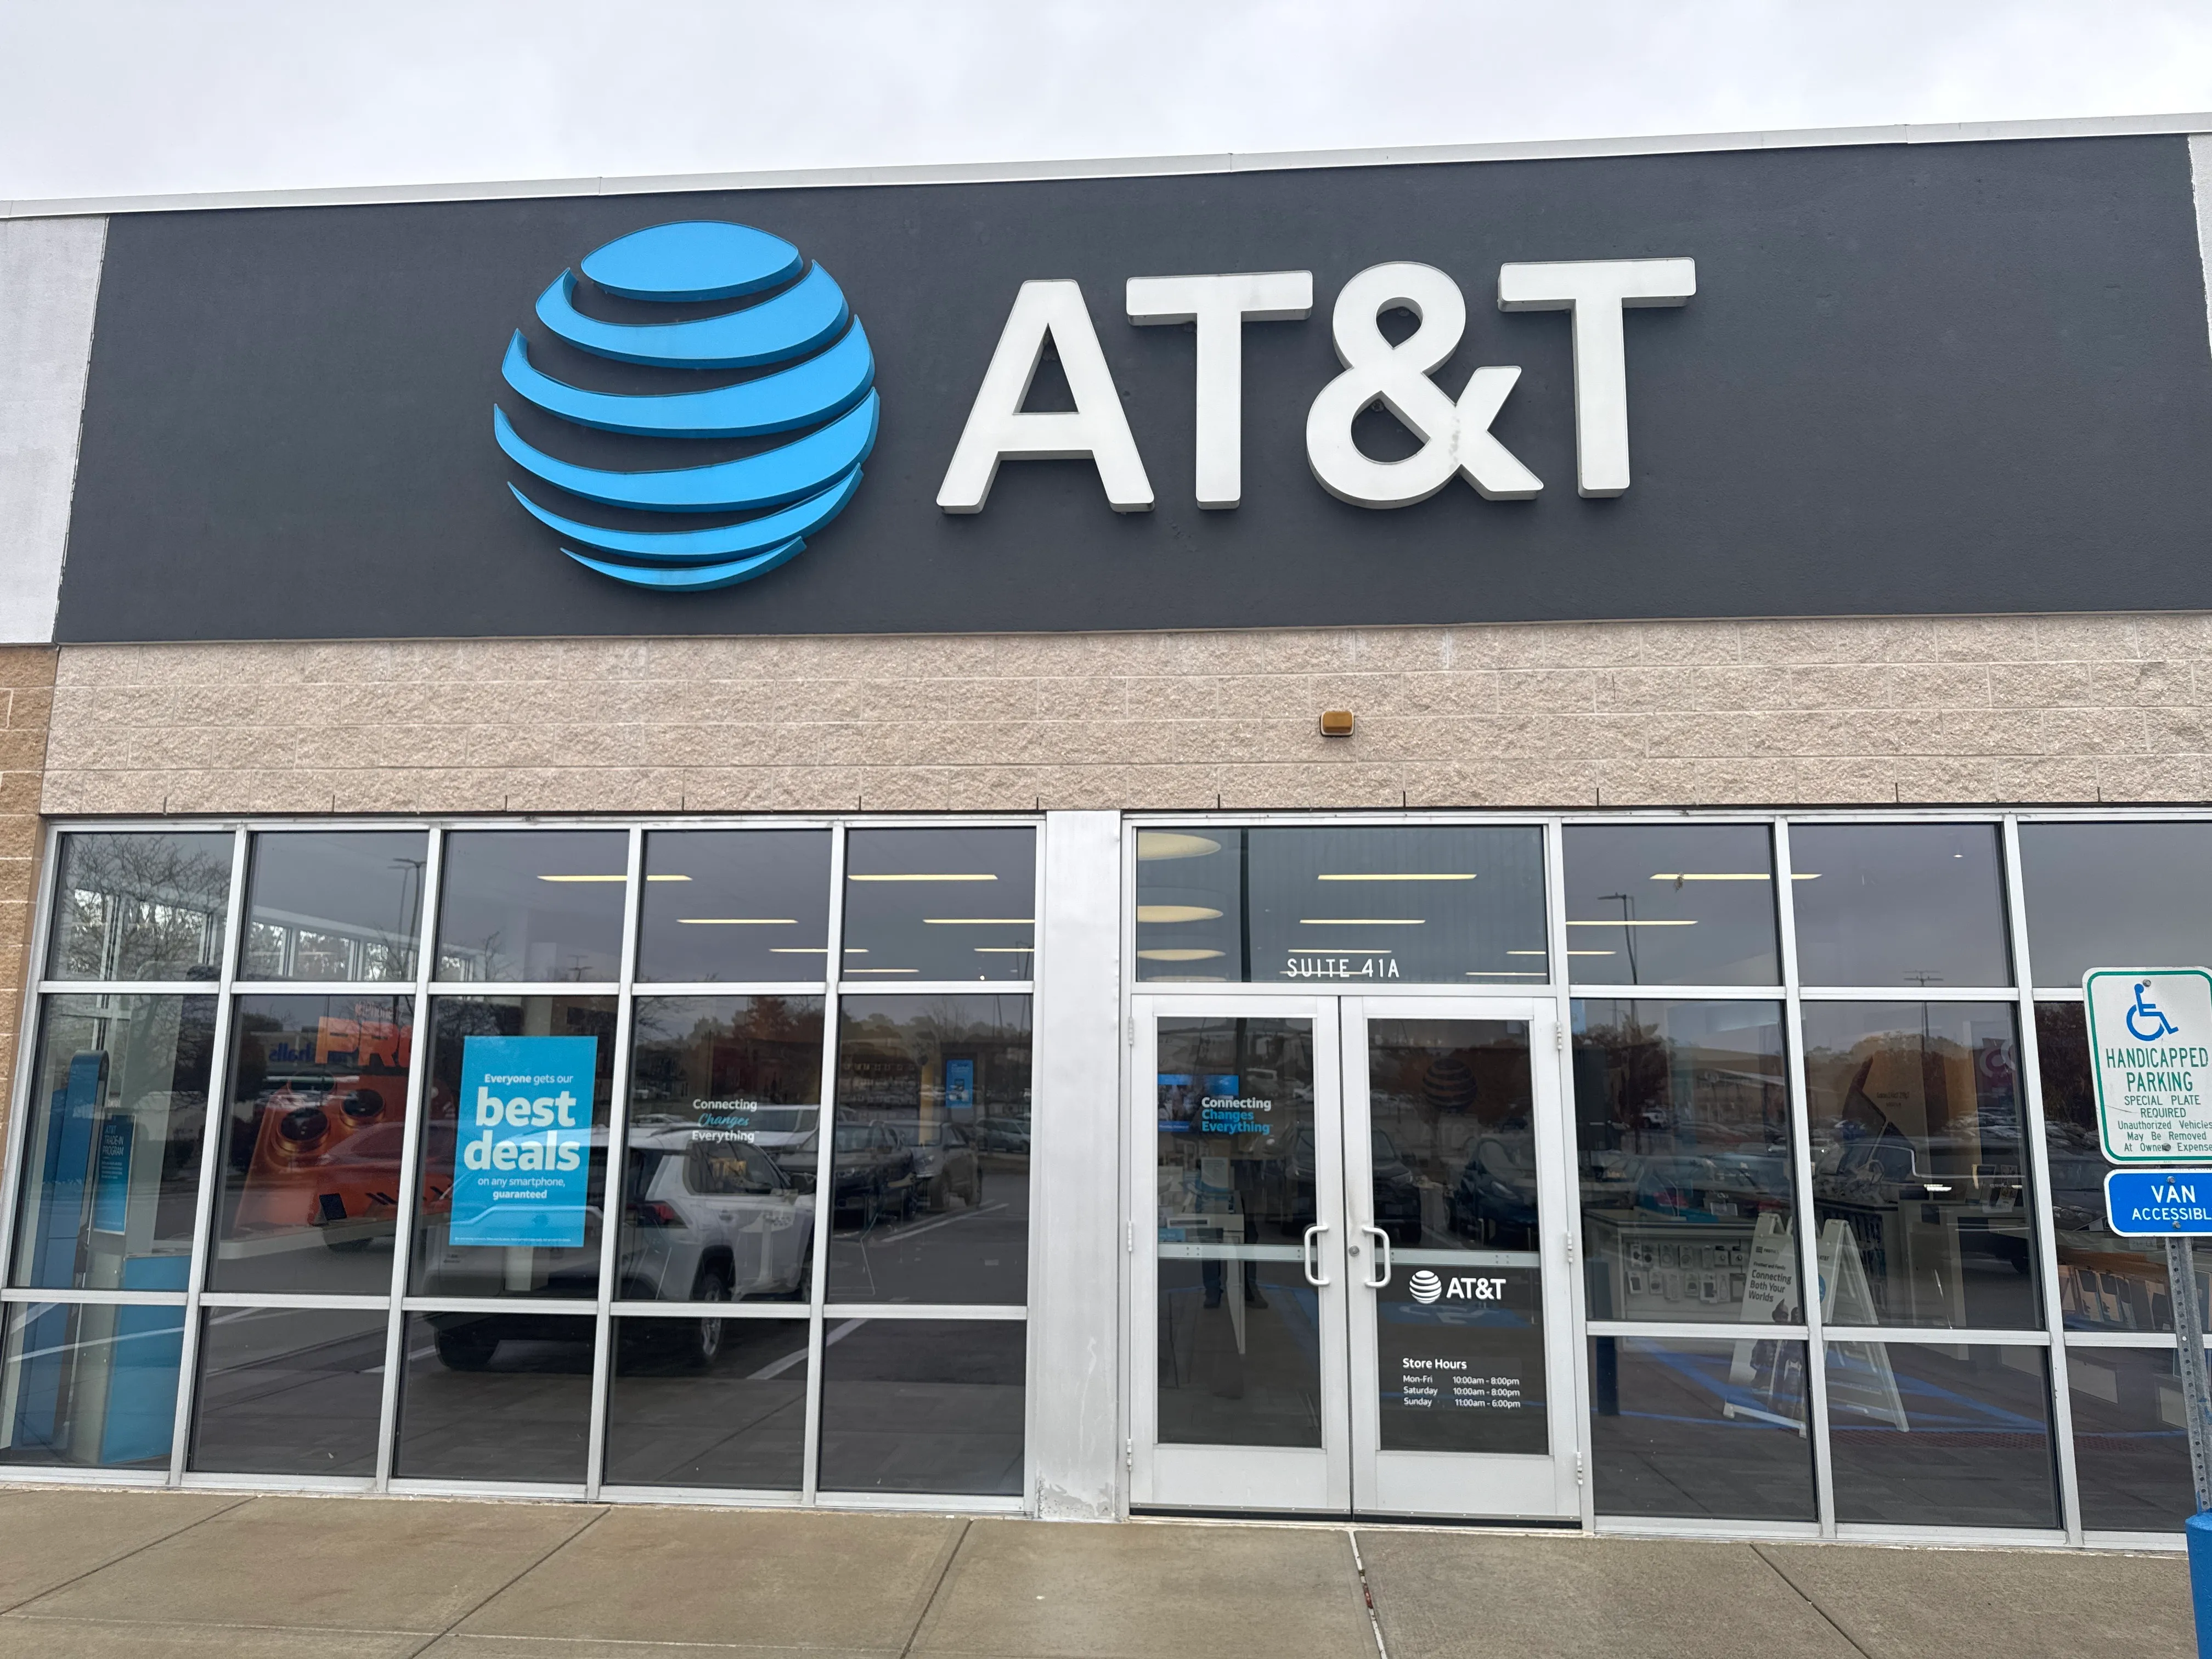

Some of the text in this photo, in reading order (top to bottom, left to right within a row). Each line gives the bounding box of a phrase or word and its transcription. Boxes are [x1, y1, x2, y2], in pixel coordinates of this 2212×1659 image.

[936, 257, 1696, 515] AT&T
[1287, 958, 1400, 978] SUITE 41A
[2106, 1047, 2209, 1068] HANDICAPPED
[485, 1074, 574, 1086] Everyone gets our
[2126, 1071, 2193, 1092] PARKING
[693, 1098, 758, 1113] Connecting
[1201, 1097, 1272, 1111] Connecting
[2124, 1094, 2201, 1105] SPECIAL PLATE
[476, 1086, 577, 1127] best
[2141, 1108, 2186, 1118] REQUIRED
[697, 1113, 750, 1129] Changes
[1201, 1108, 1254, 1122] Changes
[2118, 1120, 2212, 1130] Unauthorized Vehicles
[2127, 1131, 2207, 1142] May Be Removed
[464, 1130, 580, 1170] deals
[2124, 1143, 2133, 1152] At
[492, 1178, 508, 1187] any
[509, 1177, 566, 1187] smartphone,
[493, 1189, 548, 1200] guaranteed
[2151, 1185, 2196, 1203] VAN
[2132, 1208, 2212, 1221] ACCESSIBL
[1752, 1269, 1792, 1285] Connecting
[1446, 1277, 1506, 1300] AT&T
[1750, 1279, 1786, 1293] Both Your
[1748, 1290, 1774, 1302] Worlds
[1402, 1358, 1468, 1370] Store Hours
[1403, 1374, 1433, 1383] Mon-Fri
[1453, 1376, 1485, 1385] 10:00am
[1491, 1377, 1520, 1386] 8:00pm
[1403, 1386, 1438, 1396] Saturday
[1453, 1387, 1485, 1396] 10:00am
[1491, 1388, 1520, 1398] 8:00pm
[1403, 1397, 1433, 1408] Sunday
[1454, 1398, 1486, 1407] 11:00am
[1492, 1400, 1521, 1409] 6:00pm
